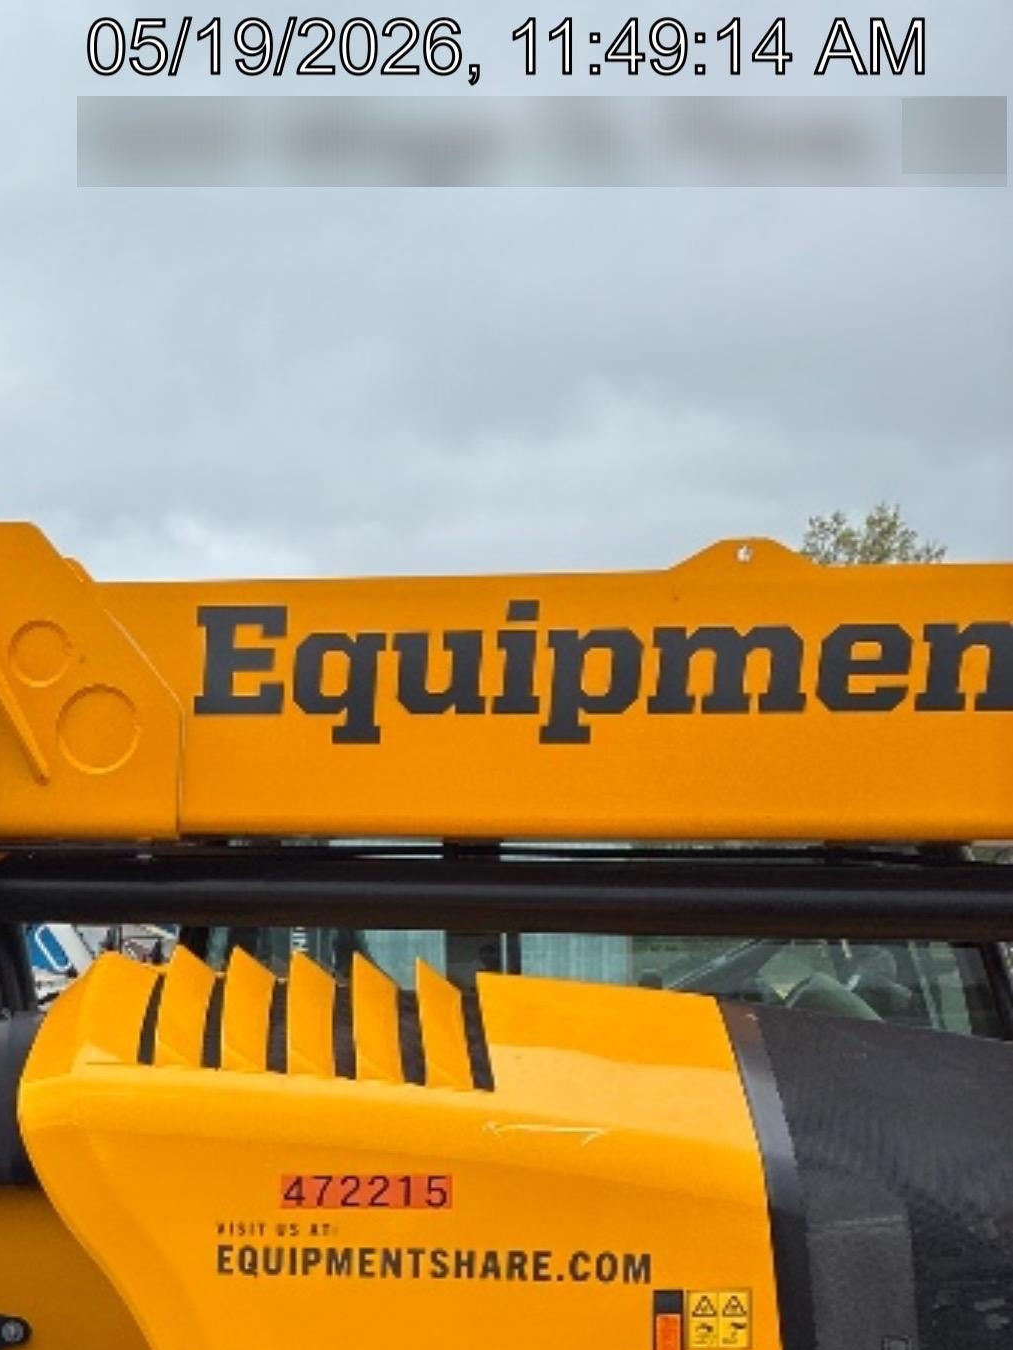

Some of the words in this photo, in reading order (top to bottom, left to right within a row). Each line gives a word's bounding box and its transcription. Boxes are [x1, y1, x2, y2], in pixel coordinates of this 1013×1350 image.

[194, 600, 1013, 745] Equipmen
[283, 1175, 448, 1208] 472215
[216, 1222, 265, 1237] VISIT
[277, 1223, 300, 1237] US
[217, 1244, 652, 1285] EQUIPMENTSHARE.COM
